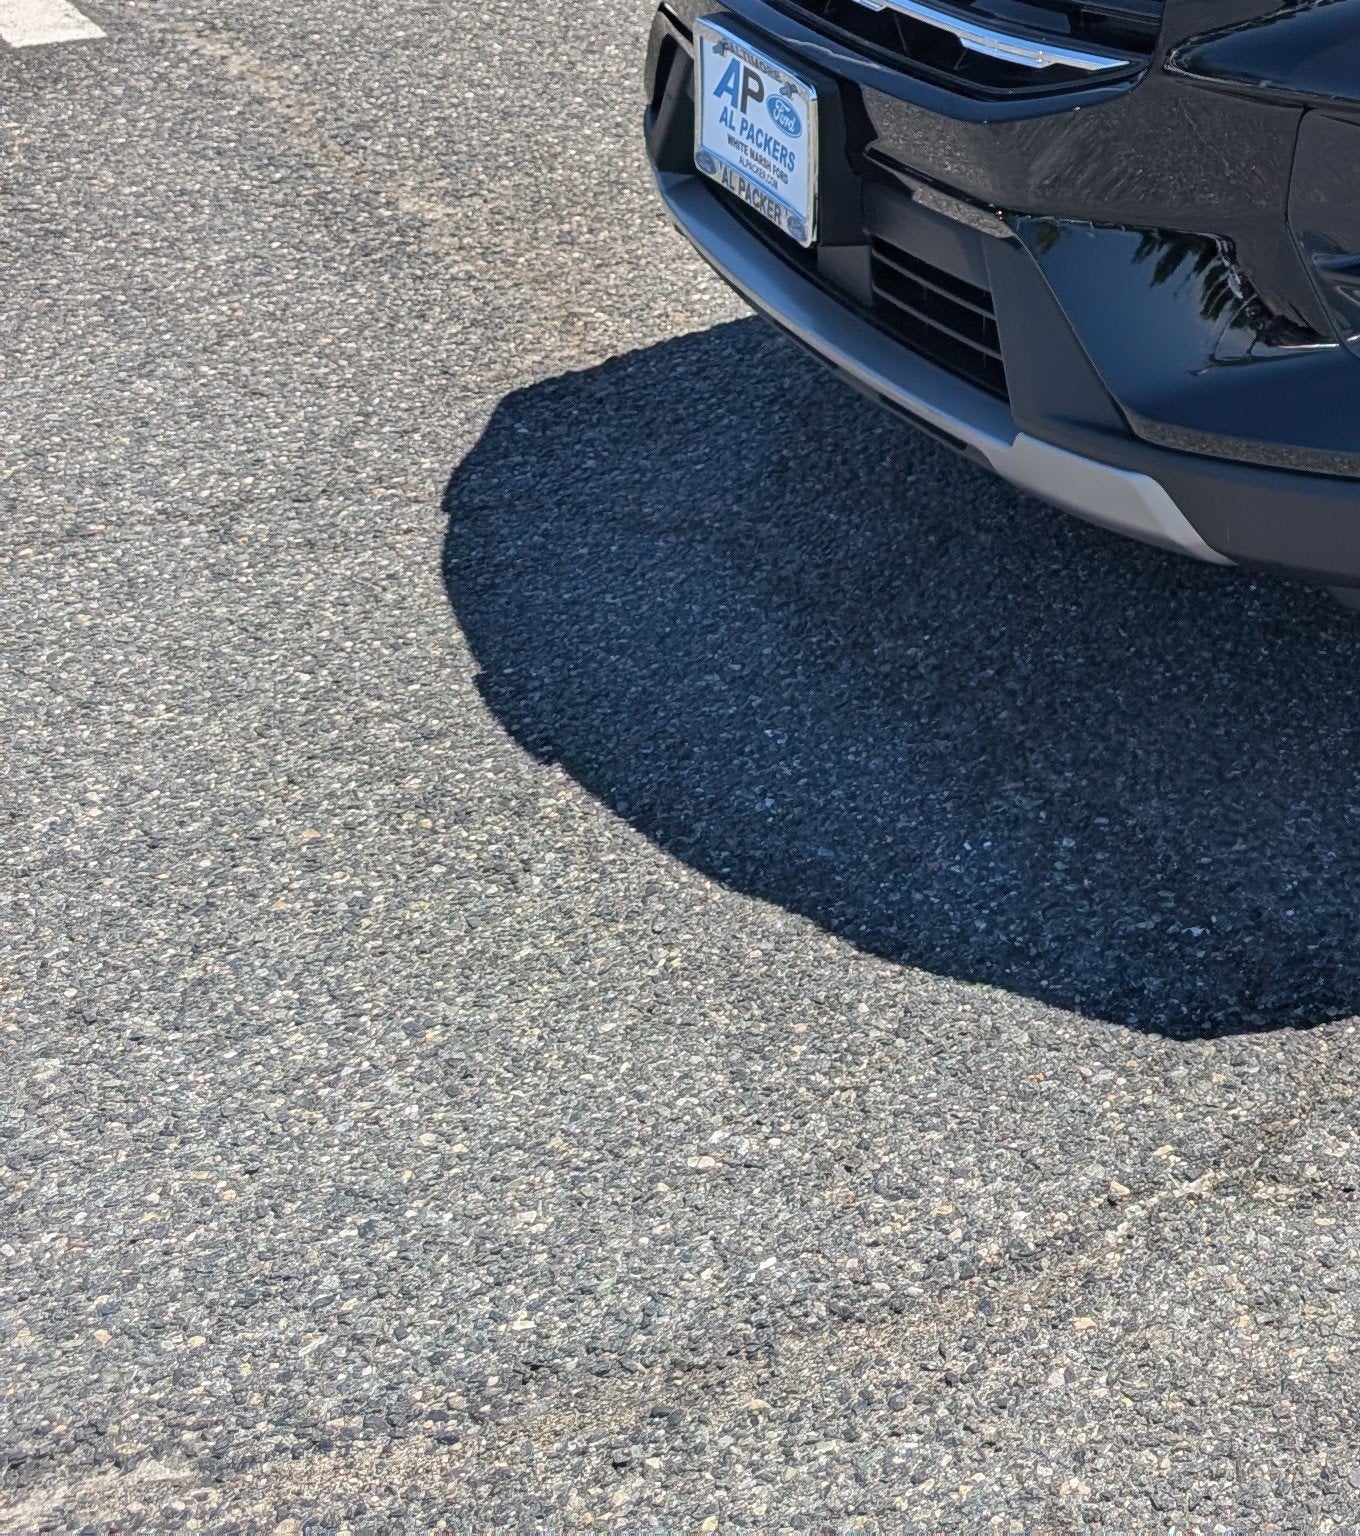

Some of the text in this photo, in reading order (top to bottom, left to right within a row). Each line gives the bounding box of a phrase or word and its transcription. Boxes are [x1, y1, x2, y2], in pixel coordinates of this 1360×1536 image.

[713, 57, 765, 115] AP
[719, 105, 736, 132] AL
[740, 117, 796, 173] PACKERS
[773, 98, 797, 132] Ford
[727, 133, 789, 185] WHITE MARSH FORD
